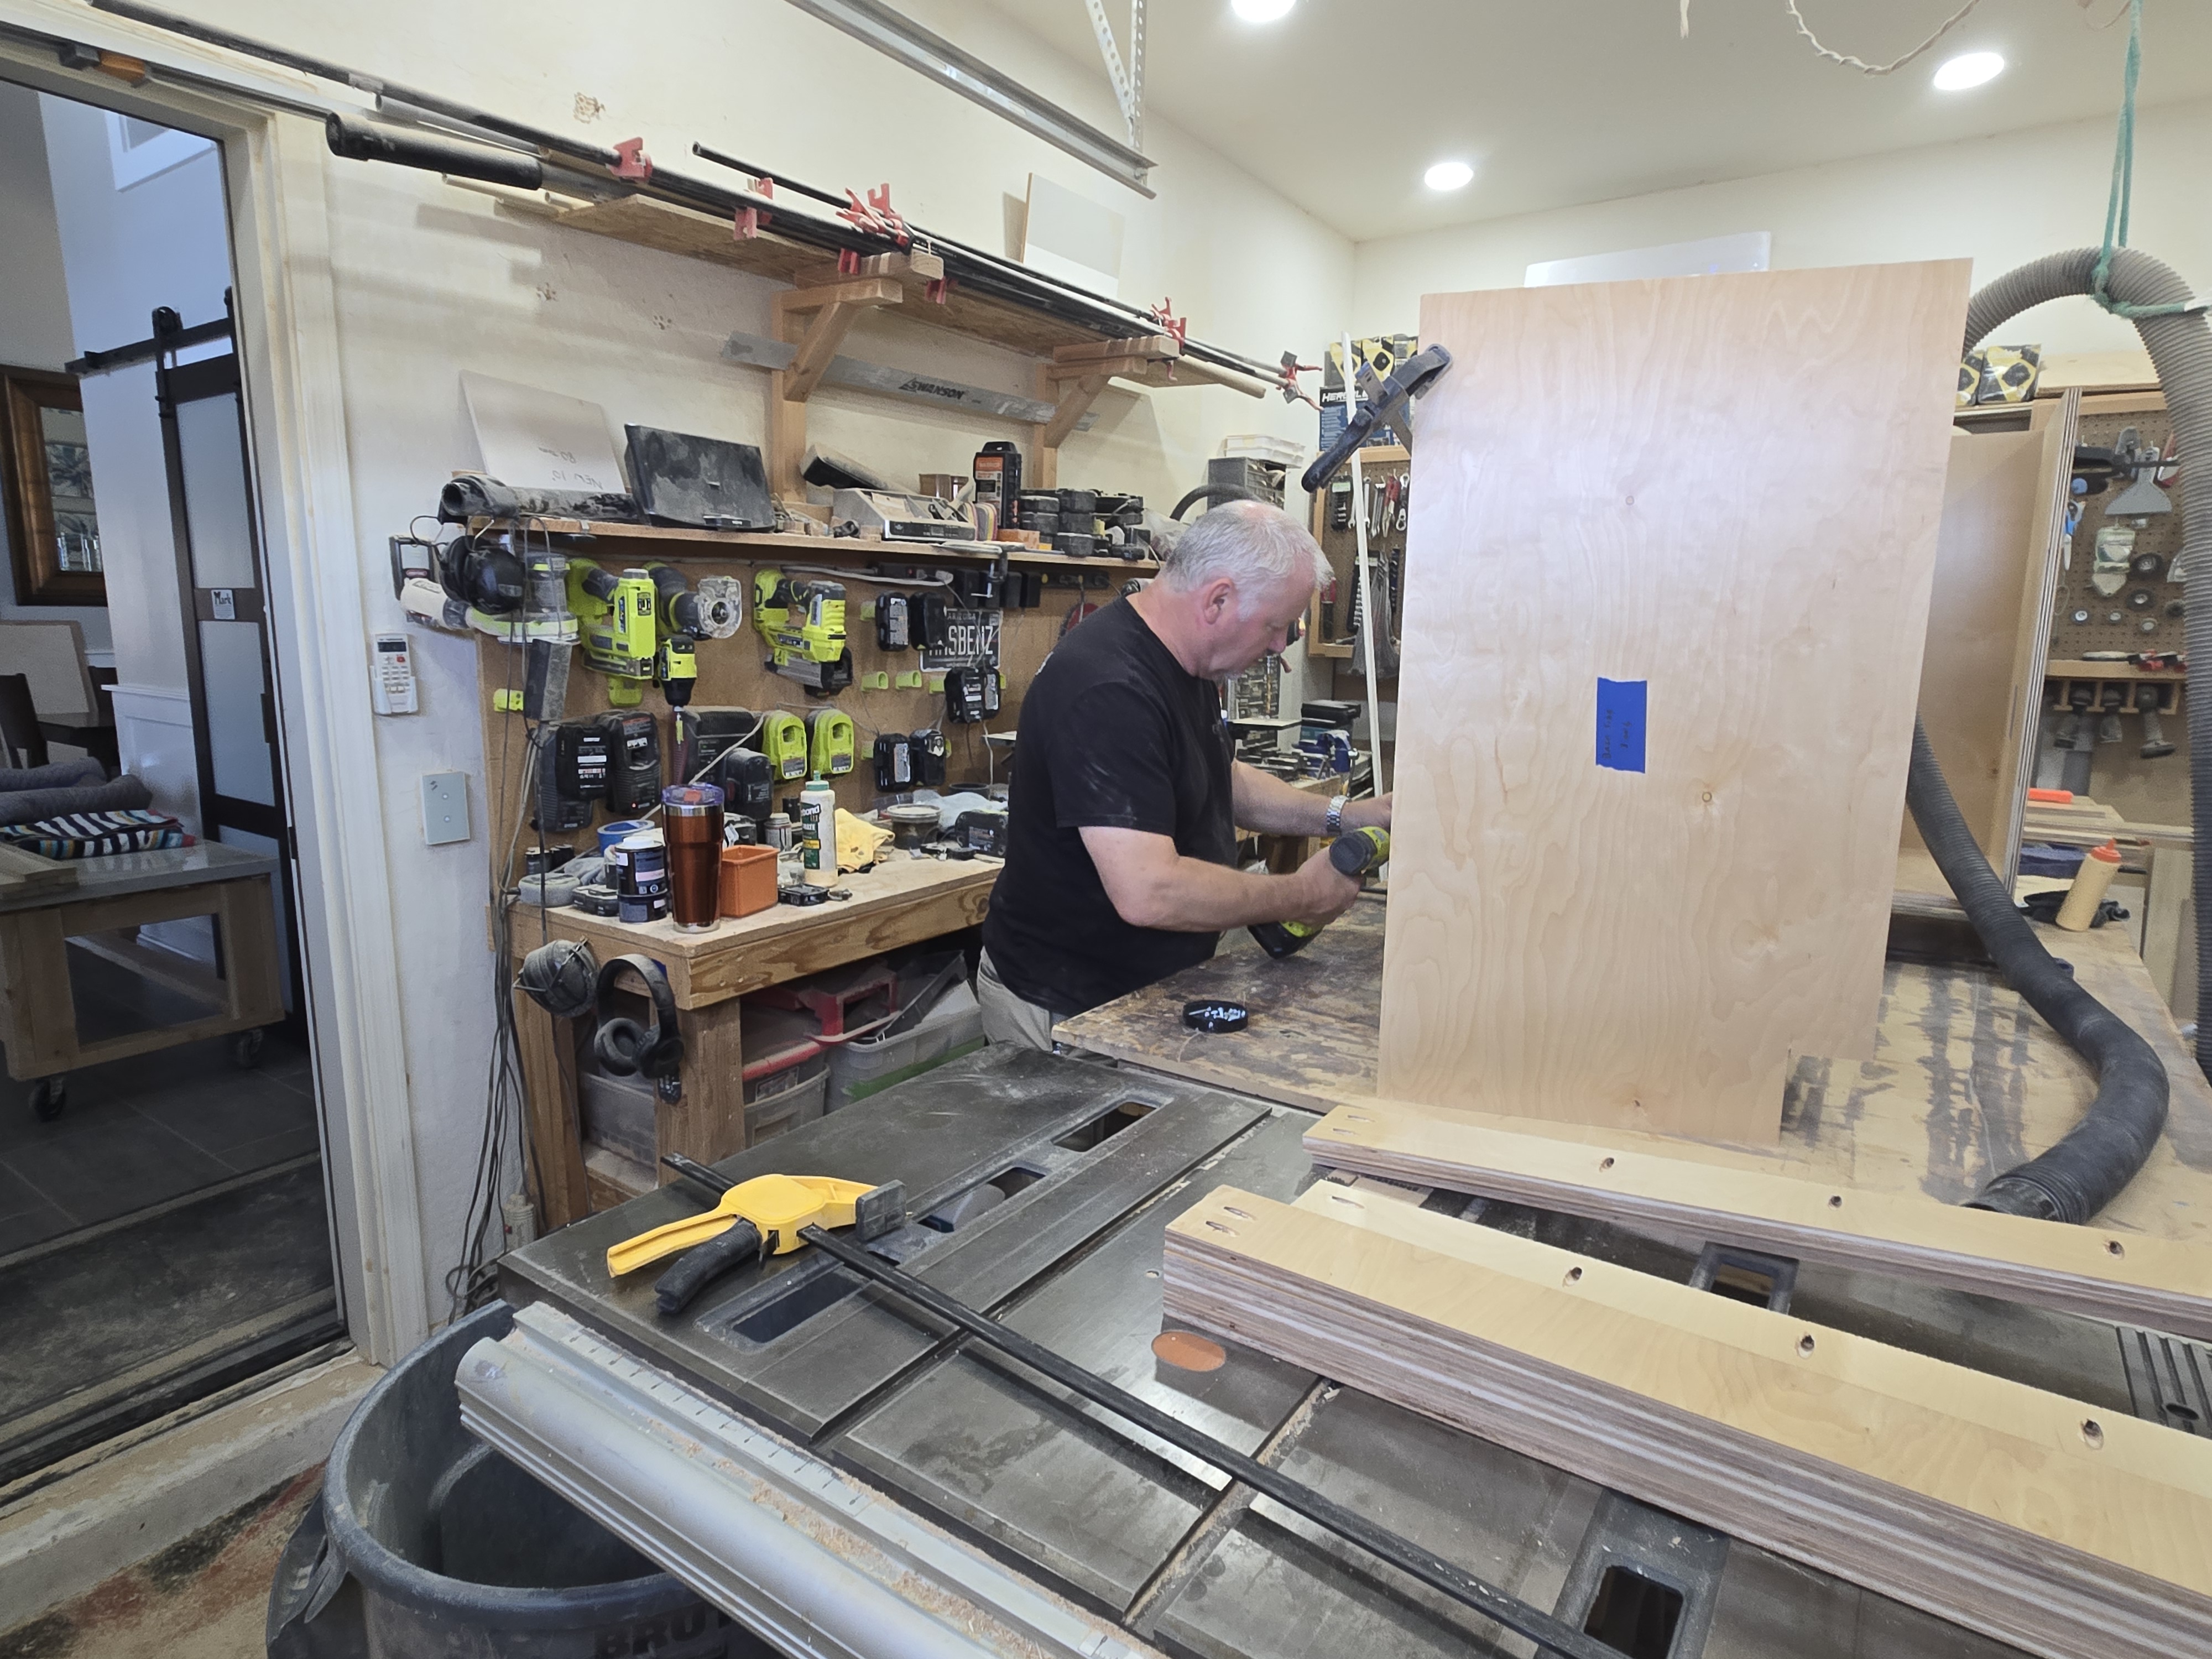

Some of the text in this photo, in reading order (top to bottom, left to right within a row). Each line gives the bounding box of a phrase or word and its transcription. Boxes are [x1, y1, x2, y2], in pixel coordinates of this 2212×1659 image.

[909, 381, 964, 399] SWANSON
[213, 591, 232, 605] Mark
[929, 625, 993, 655] SBENZ
